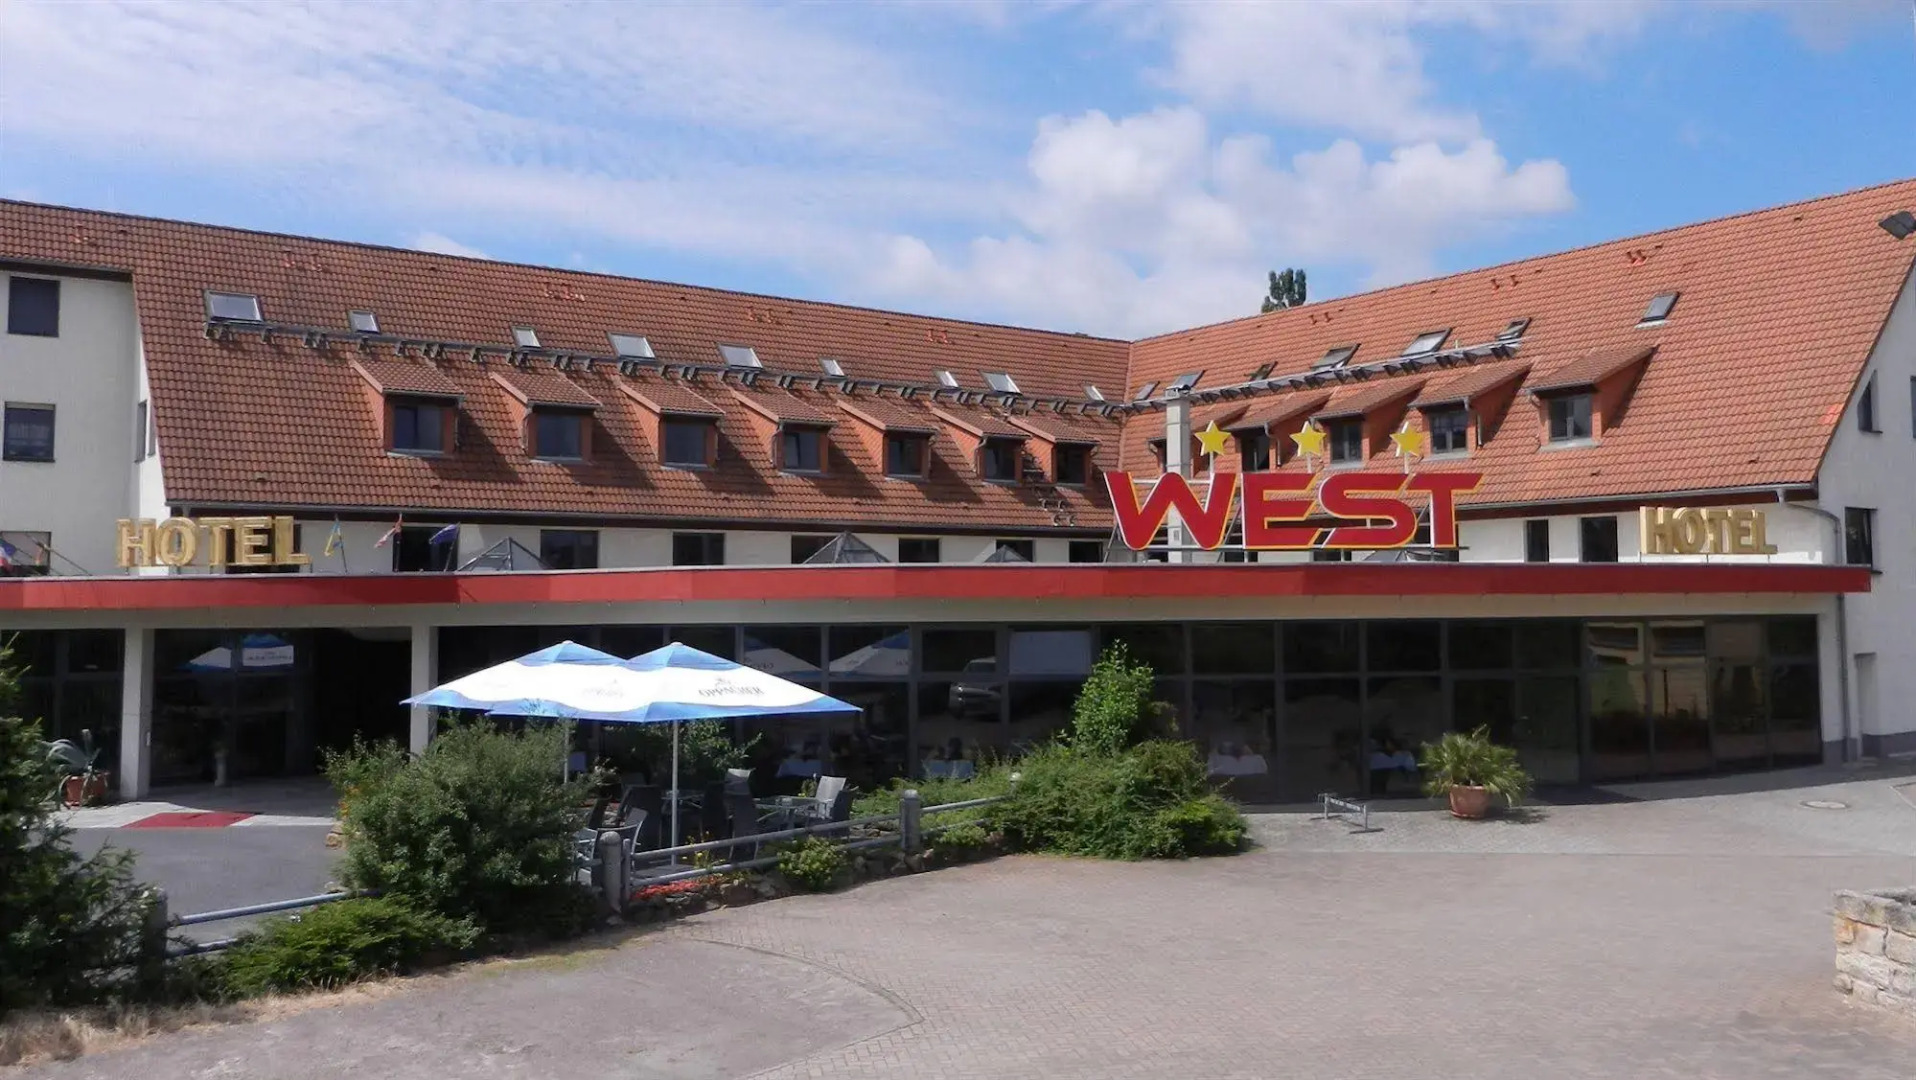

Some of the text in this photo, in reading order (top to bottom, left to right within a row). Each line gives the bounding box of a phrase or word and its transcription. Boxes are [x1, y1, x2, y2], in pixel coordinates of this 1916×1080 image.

[1104, 472, 1483, 551] WEST
[1639, 506, 1778, 554] HOTEL
[116, 516, 312, 567] HOTEL
